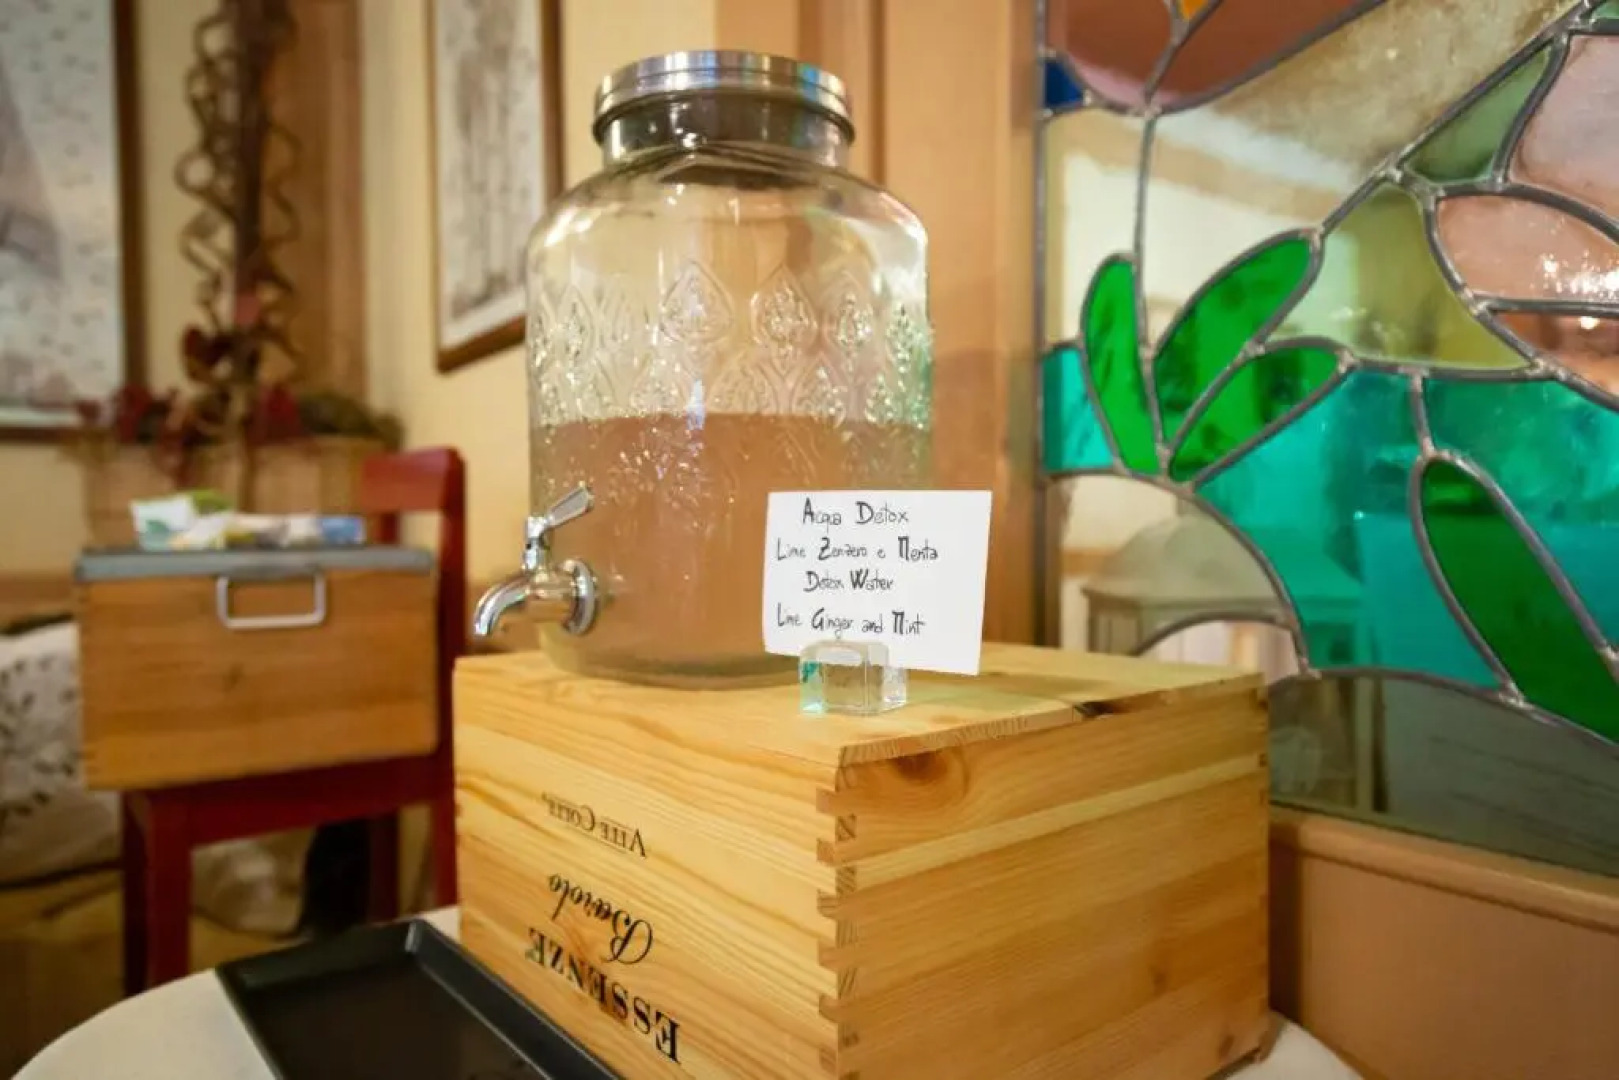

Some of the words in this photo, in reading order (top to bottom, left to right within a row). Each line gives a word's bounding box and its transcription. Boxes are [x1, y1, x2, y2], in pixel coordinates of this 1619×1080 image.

[802, 497, 841, 533] Acqua
[855, 500, 909, 525] Detox
[817, 536, 868, 561] Zenzero
[877, 549, 886, 559] e
[897, 536, 939, 562] Menta
[803, 570, 845, 592] Detox
[850, 568, 894, 591] Water
[811, 607, 854, 640] Ginger
[862, 612, 883, 634] and
[892, 610, 927, 635] Mint
[547, 873, 654, 965] Barolo
[525, 926, 681, 1065] ESSENZE
